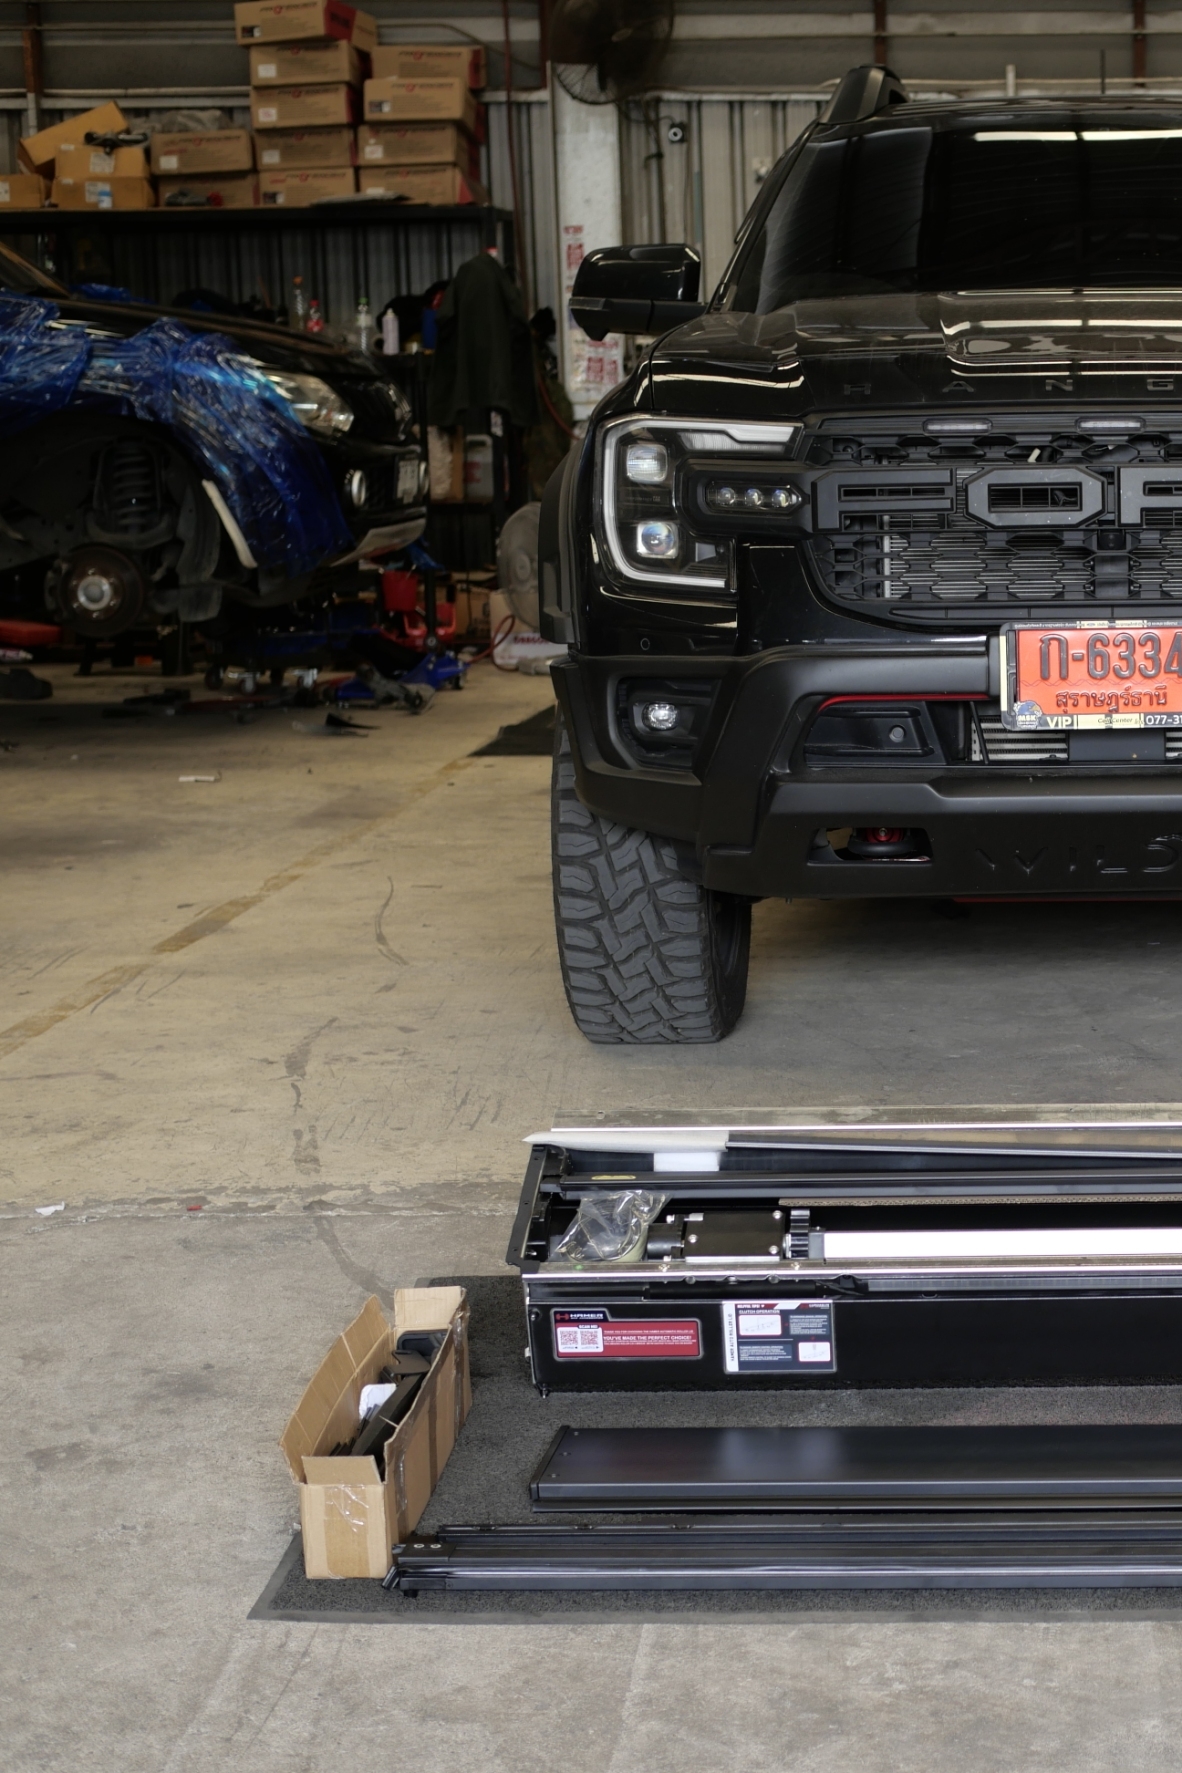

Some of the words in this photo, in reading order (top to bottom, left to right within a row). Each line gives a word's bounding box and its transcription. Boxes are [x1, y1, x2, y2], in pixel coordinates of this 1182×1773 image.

[1056, 685, 1167, 713] สุราษฎร์ธานี
[1046, 717, 1071, 729] VIP
[976, 843, 1181, 874] WILD
